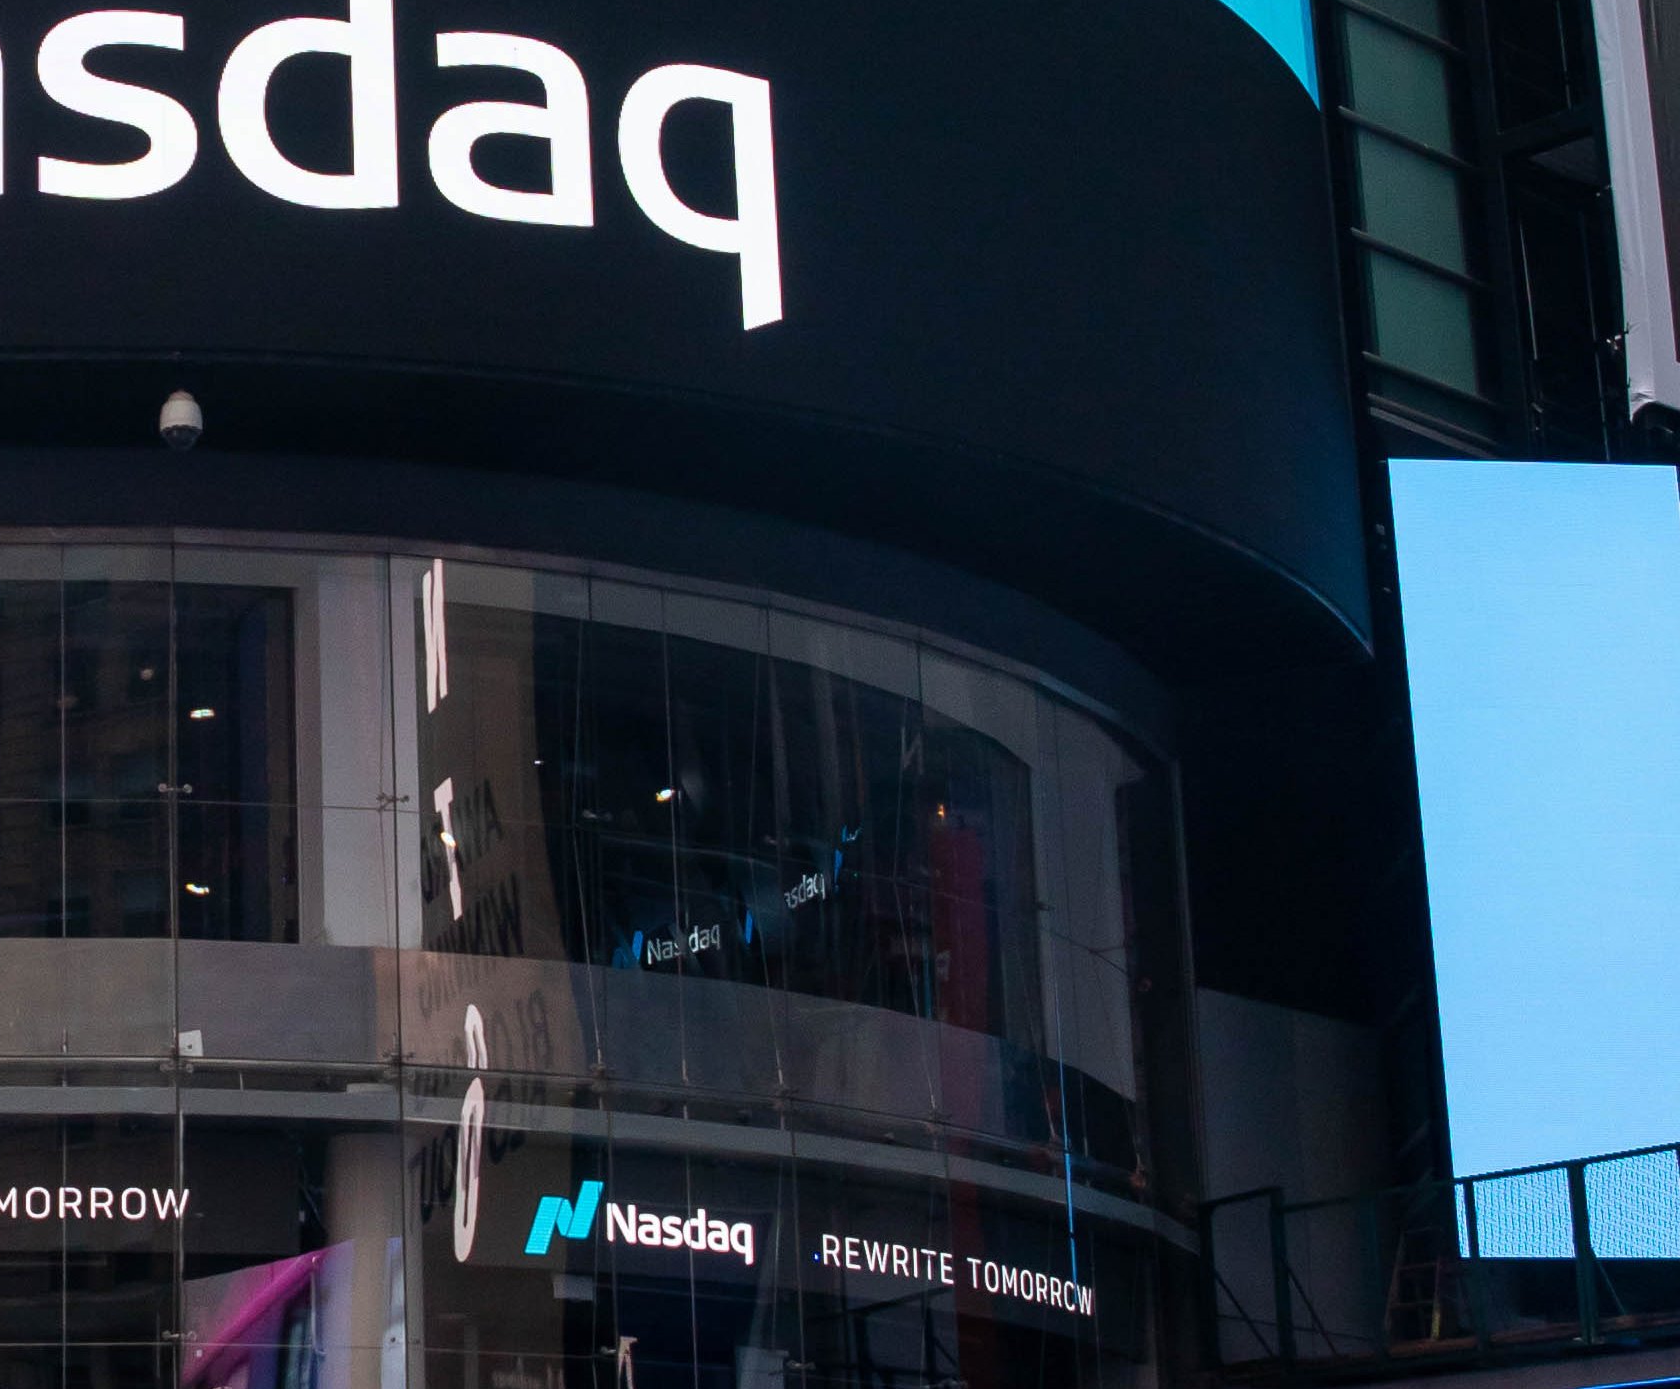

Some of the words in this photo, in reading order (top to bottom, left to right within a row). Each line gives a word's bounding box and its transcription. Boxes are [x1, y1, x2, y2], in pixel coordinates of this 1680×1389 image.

[606, 1203, 755, 1266] Nasdaq
[822, 1234, 954, 1286] REWRITE
[967, 1257, 1094, 1317] TOMORROW
